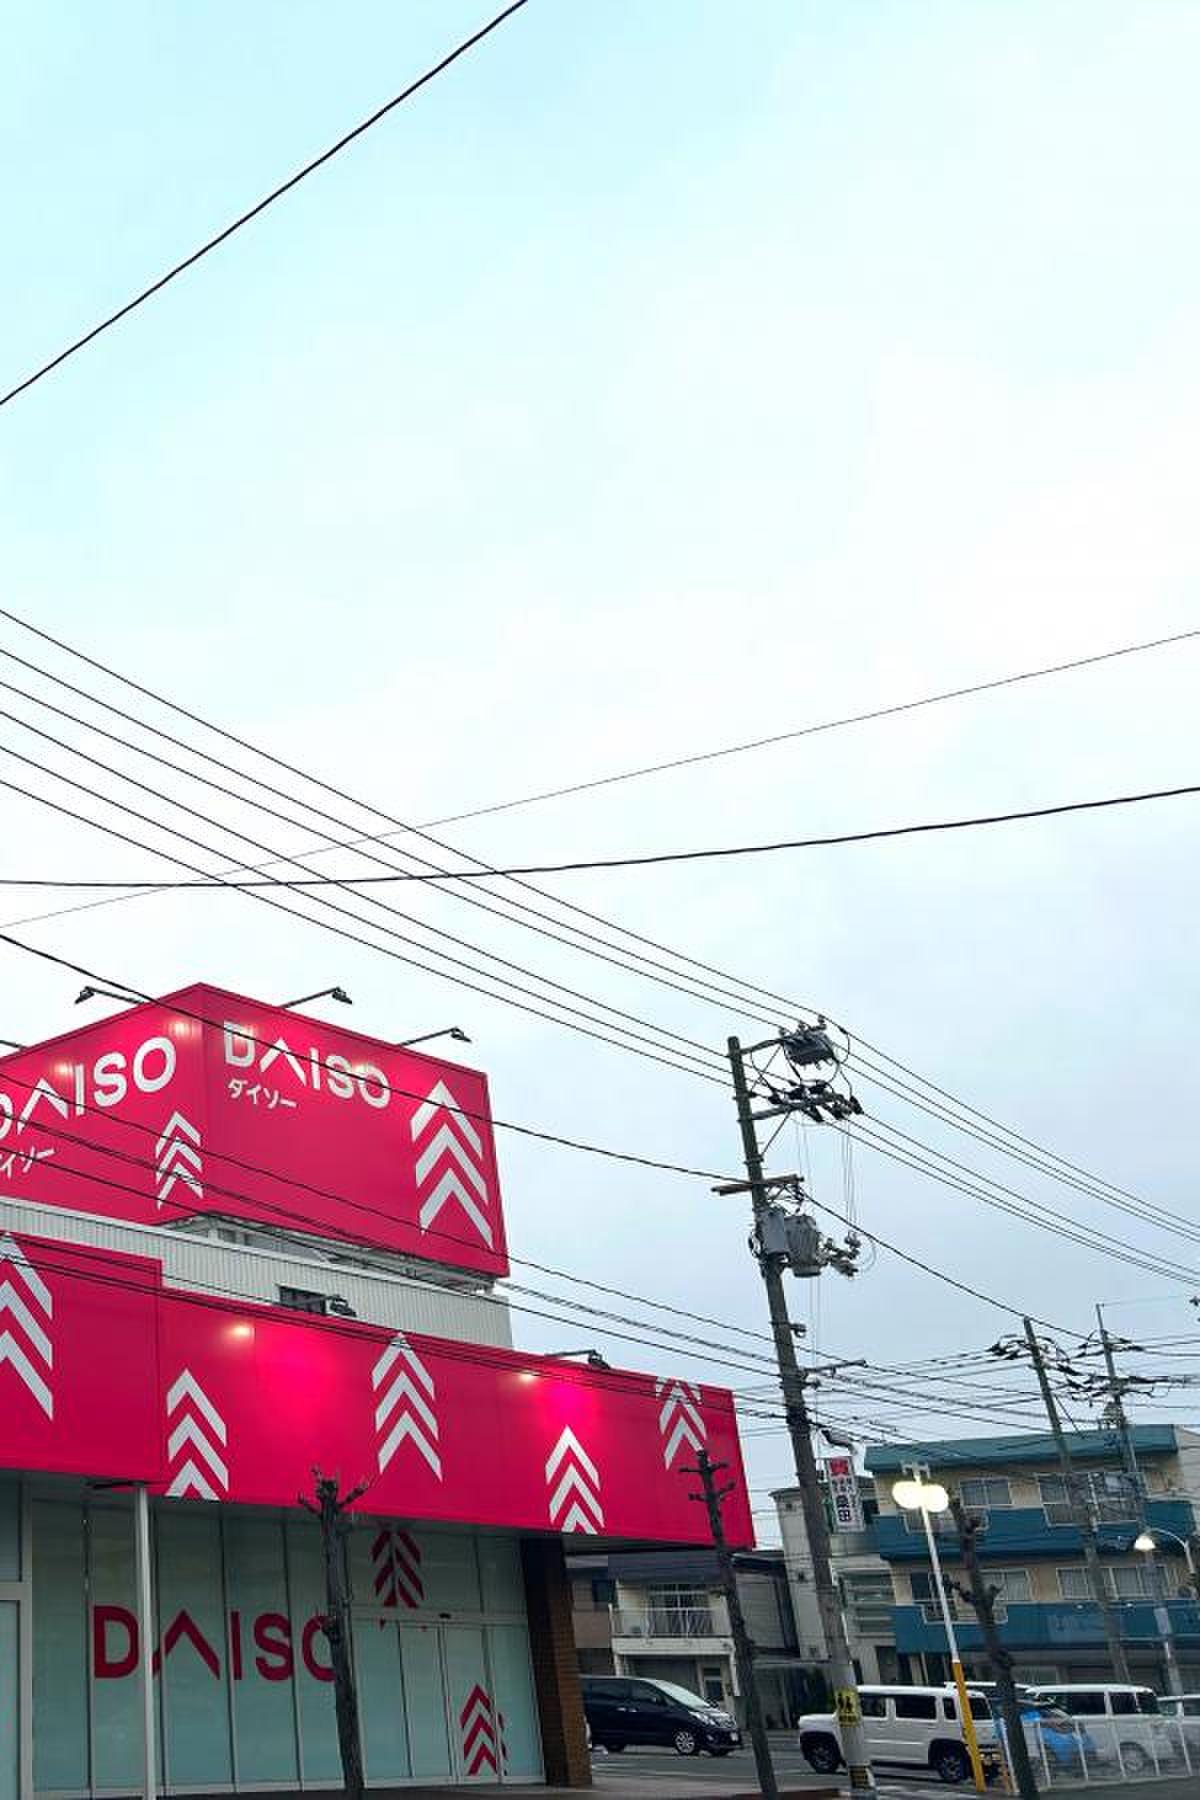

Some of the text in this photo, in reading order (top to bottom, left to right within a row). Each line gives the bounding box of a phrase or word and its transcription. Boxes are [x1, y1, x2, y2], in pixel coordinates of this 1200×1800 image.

[223, 1021, 391, 1109] DAISO
[228, 1079, 297, 1109] ダイソー
[93, 1604, 337, 1682] DAISO
